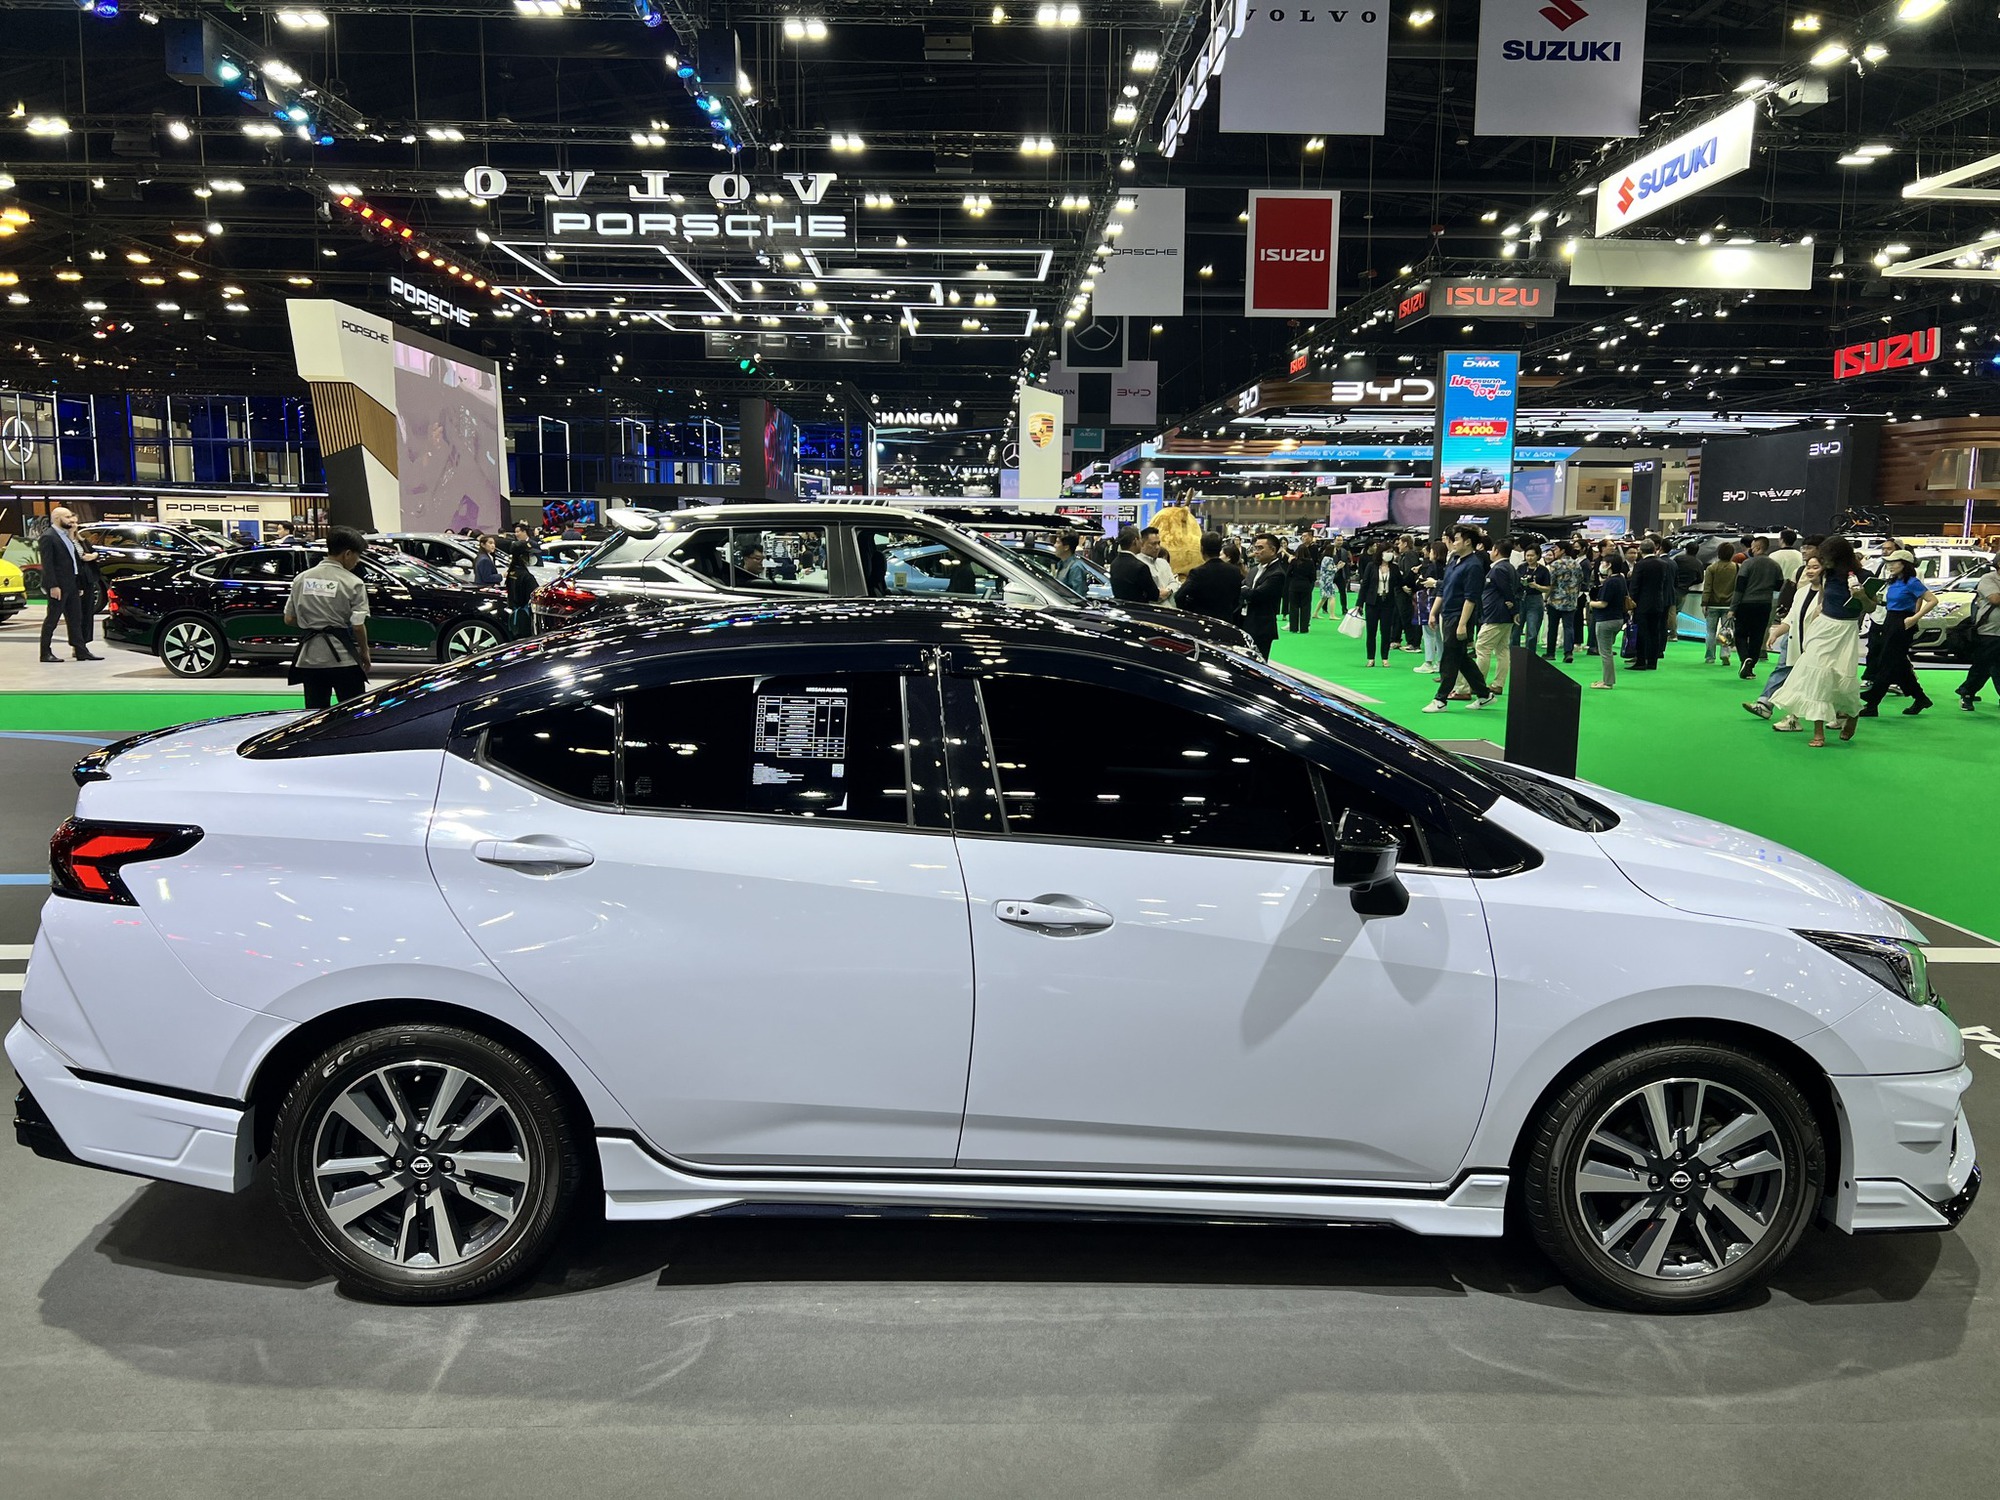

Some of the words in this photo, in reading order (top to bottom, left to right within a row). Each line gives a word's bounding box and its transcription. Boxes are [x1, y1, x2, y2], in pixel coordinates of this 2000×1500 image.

[1502, 40, 1621, 62] SUZUKI
[1638, 136, 1718, 200] SUZUKI
[552, 212, 847, 238] PORSCHE
[1111, 248, 1178, 256] ORSCHE
[1260, 248, 1325, 262] ISUZU
[390, 276, 471, 328] PORSCHE
[1398, 290, 1427, 319] ISUZU
[1446, 287, 1540, 307] ISUZU
[341, 319, 390, 344] PORSCHE
[1833, 327, 1941, 380] ISUZU
[1289, 355, 1307, 374] ISUZU
[1116, 388, 1151, 397] BYD
[1331, 378, 1436, 402] BYD
[1455, 426, 1494, 436] 24,000
[1808, 441, 1842, 456] BYD
[1633, 461, 1655, 473] BYD
[1722, 490, 1746, 502] BYD
[166, 503, 260, 512] PORSCHE
